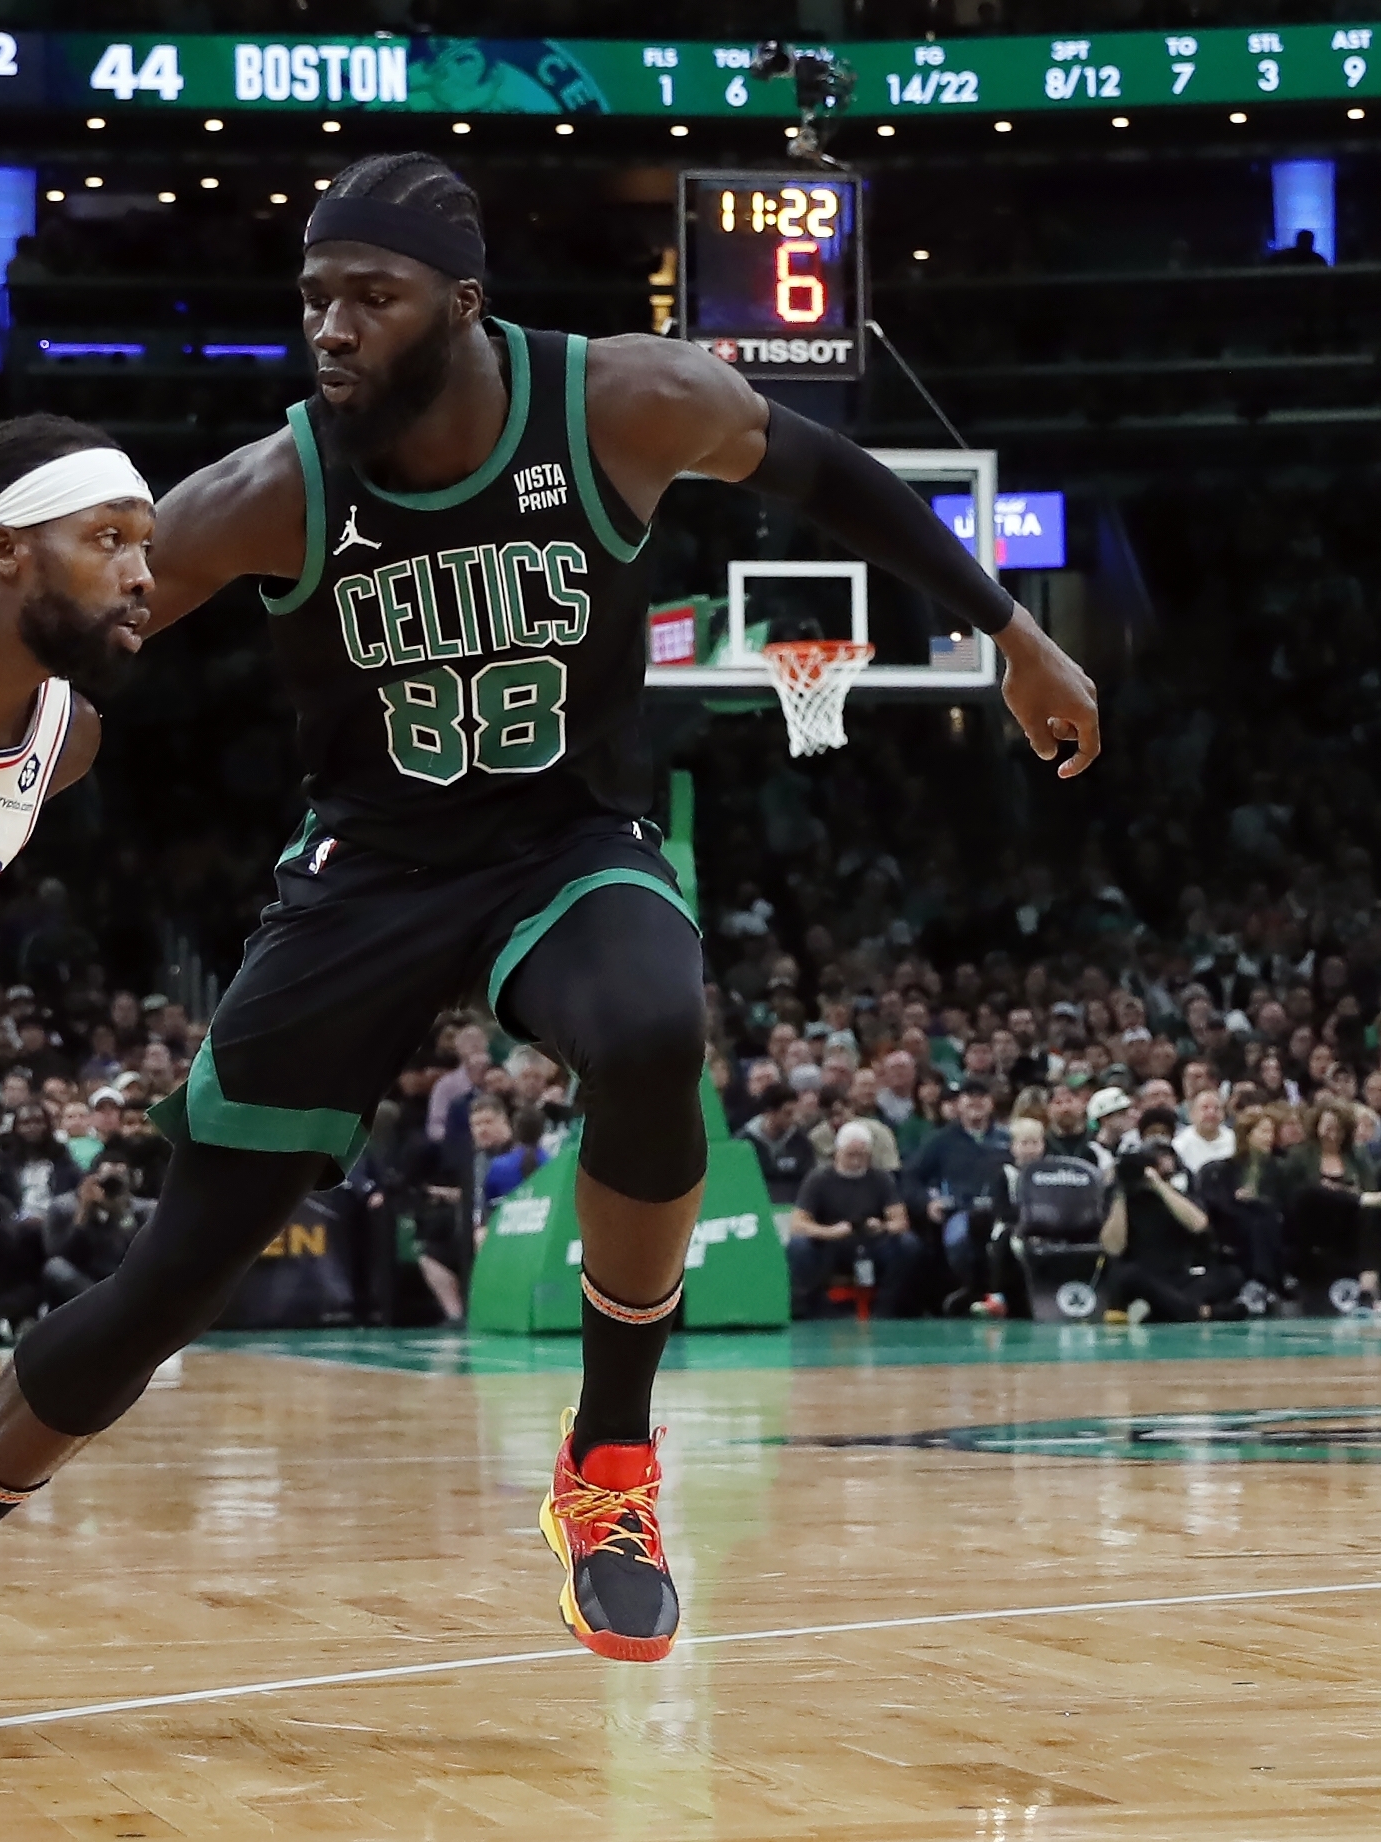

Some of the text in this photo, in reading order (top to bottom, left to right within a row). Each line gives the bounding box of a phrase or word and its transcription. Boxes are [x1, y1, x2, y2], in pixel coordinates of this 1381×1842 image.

[90, 43, 407, 103] 44 BOSTON
[643, 47, 678, 68] FLS
[915, 46, 946, 66] FG
[1051, 40, 1090, 61] 3PT
[1165, 36, 1198, 57] TO
[1248, 32, 1284, 54] STL
[1331, 29, 1372, 50] AST
[659, 55, 1366, 107] 1 6 14/22 8/12 7 3 9
[721, 188, 838, 237] 11:22
[777, 240, 824, 323] 6
[737, 338, 854, 364] TISSOT
[513, 463, 566, 494] VISTA
[519, 486, 568, 514] PRINT
[953, 512, 1042, 538] UTRA
[333, 541, 590, 669] CELTICS
[377, 655, 567, 786] 88
